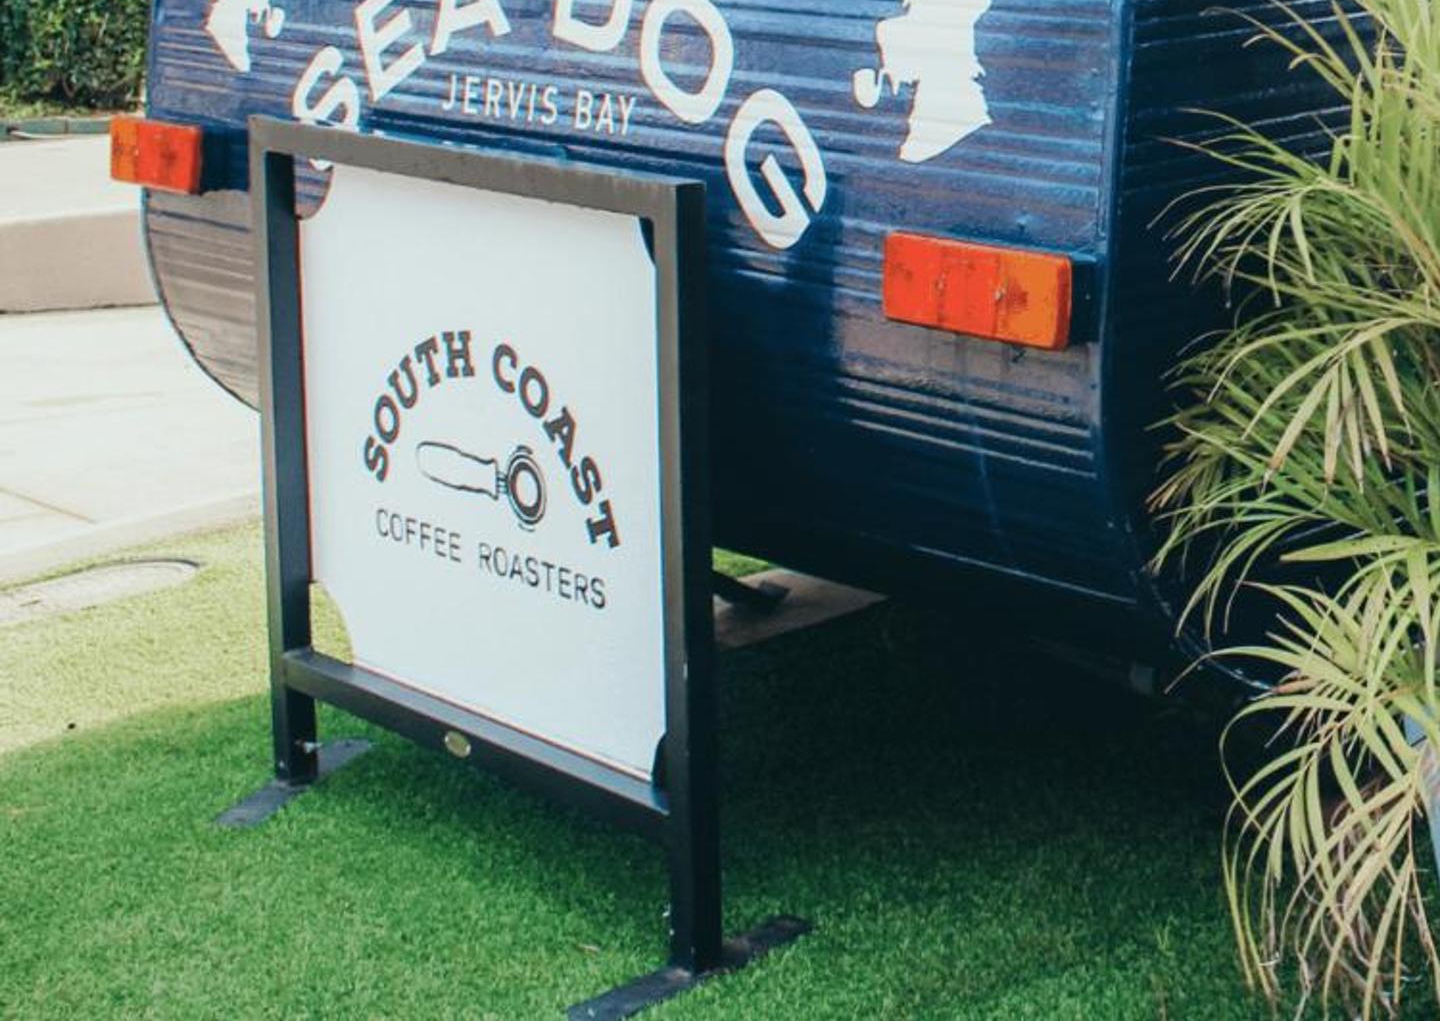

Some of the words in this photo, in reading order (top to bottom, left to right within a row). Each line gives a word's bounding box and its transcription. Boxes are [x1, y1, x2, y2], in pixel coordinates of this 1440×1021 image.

[441, 74, 559, 125] JERVIS
[574, 88, 638, 137] BAY
[363, 329, 476, 483] SOUTH
[491, 342, 620, 550] COAST
[375, 508, 462, 564] COFFEE
[478, 542, 607, 610] ROASTERS
